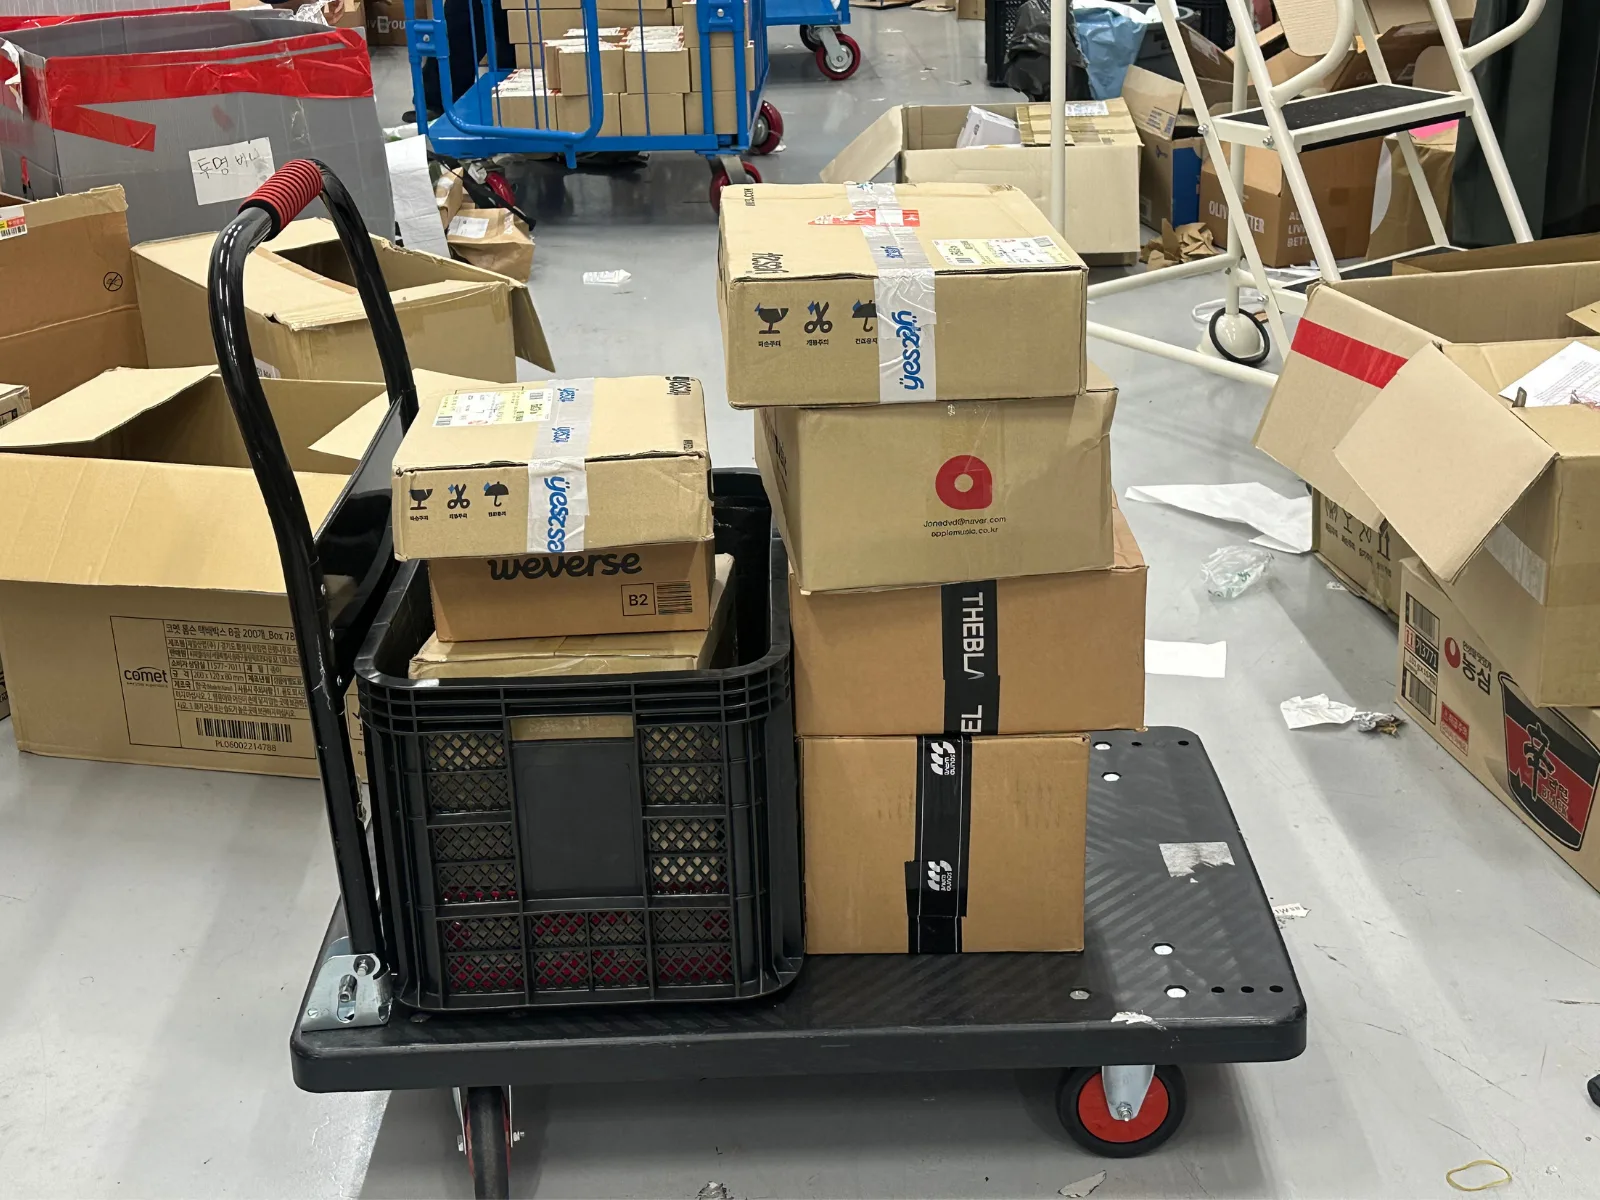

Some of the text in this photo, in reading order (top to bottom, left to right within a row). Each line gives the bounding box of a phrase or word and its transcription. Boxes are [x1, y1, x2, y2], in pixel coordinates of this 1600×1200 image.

[487, 552, 642, 581] weverse
[628, 593, 649, 606] B2
[166, 623, 181, 635] 코멧
[124, 668, 168, 684] comet
[1462, 653, 1491, 696] 농심
[1523, 722, 1556, 802] 辛
[1541, 784, 1569, 820] BLACK
[1548, 775, 1569, 804] 라면
